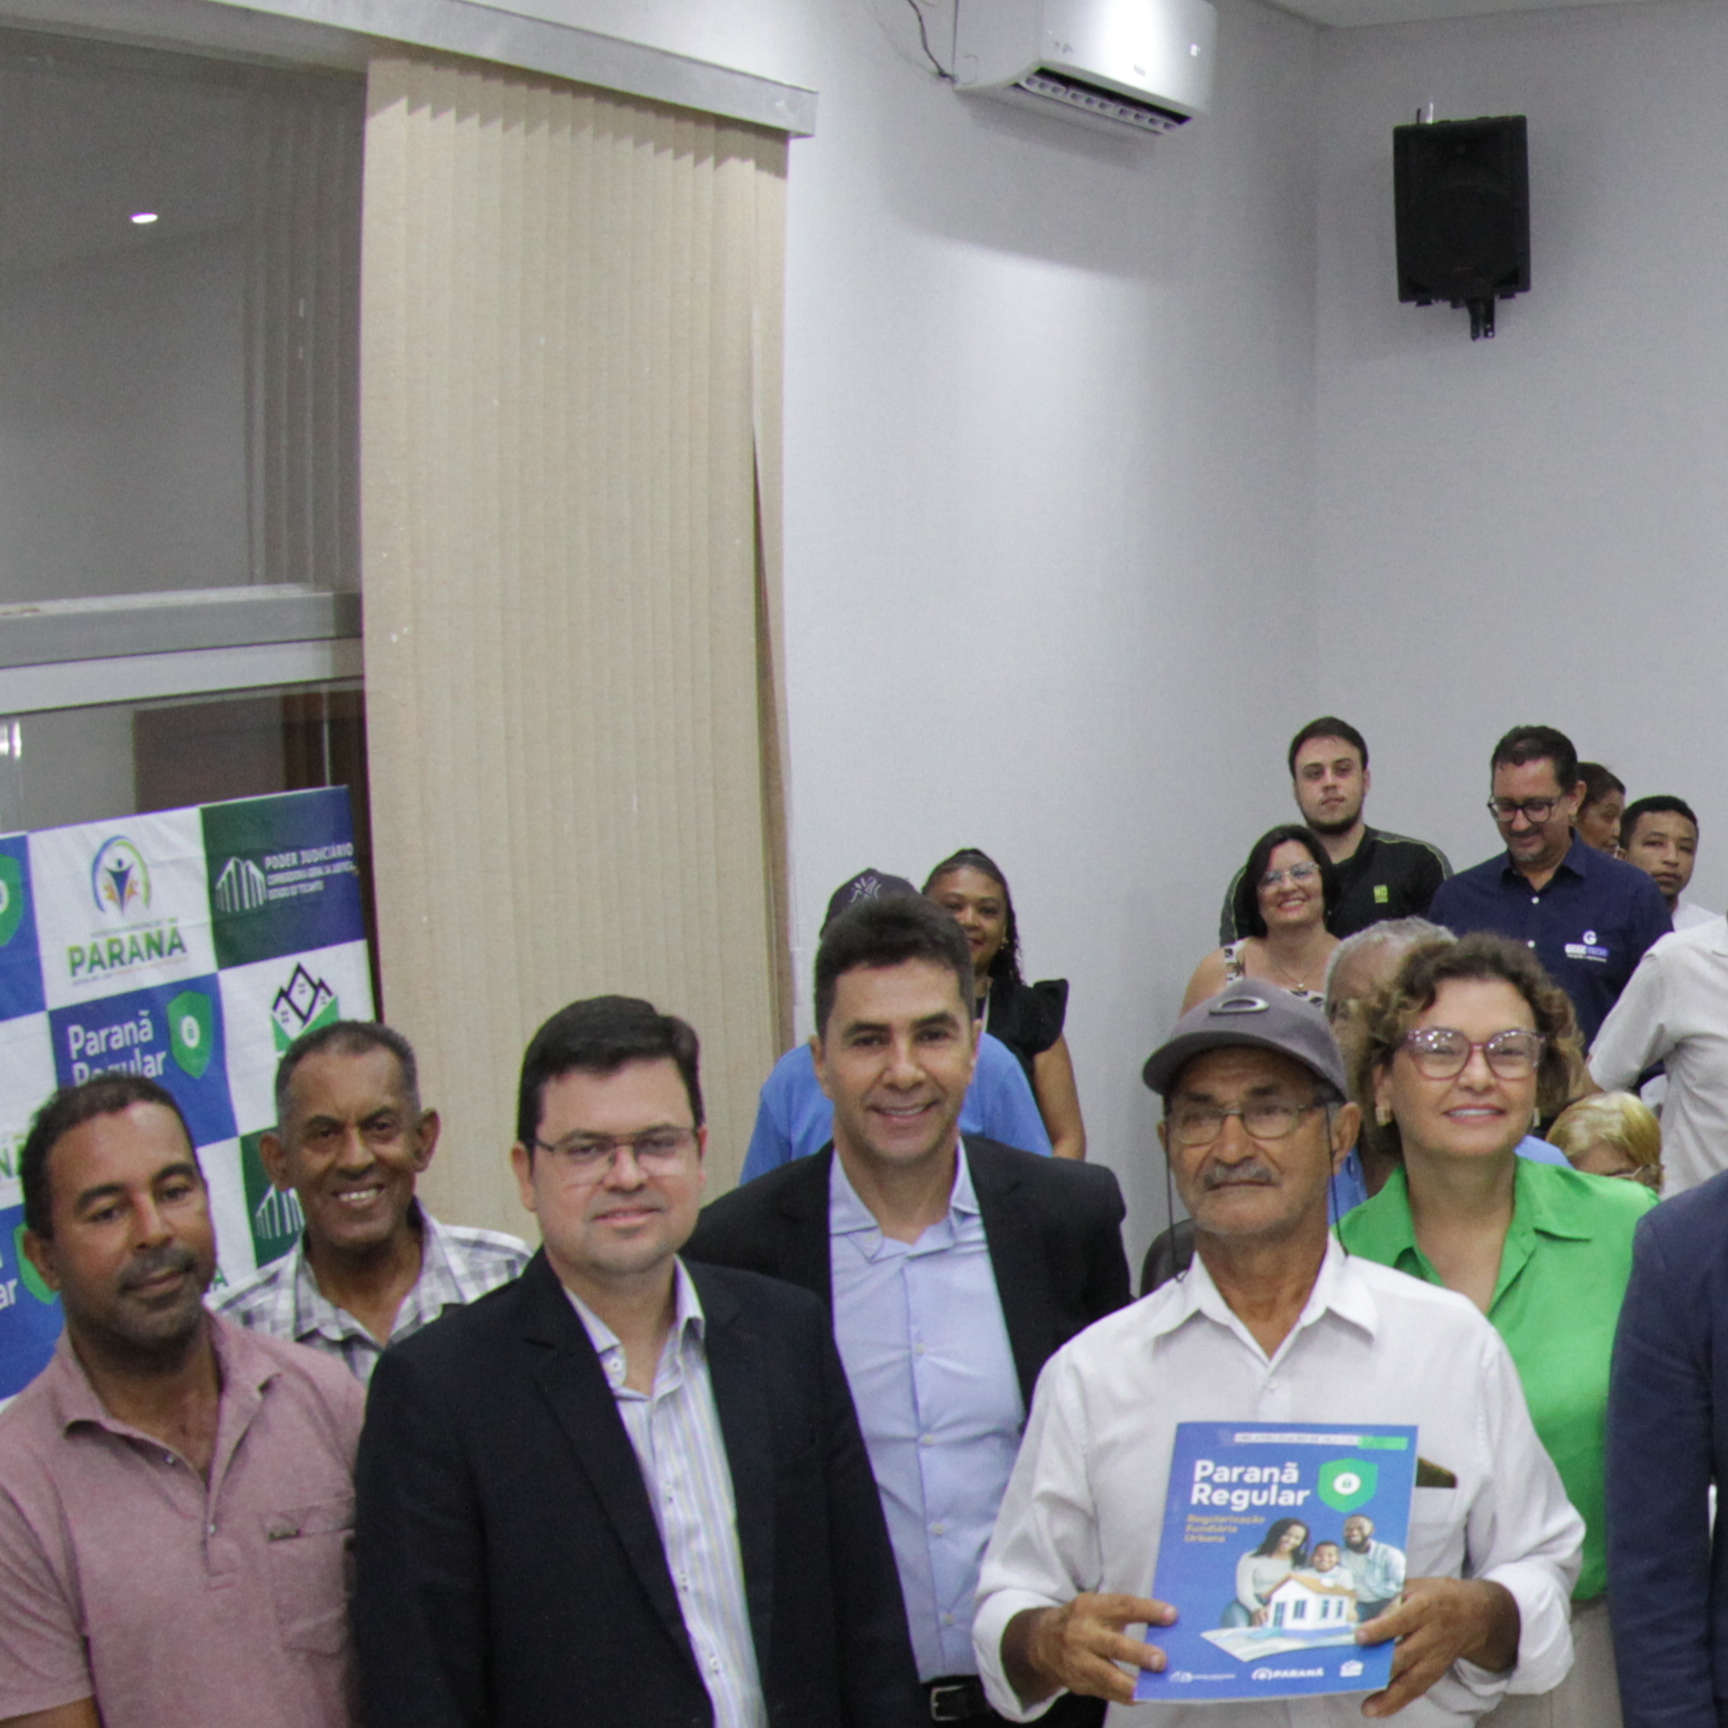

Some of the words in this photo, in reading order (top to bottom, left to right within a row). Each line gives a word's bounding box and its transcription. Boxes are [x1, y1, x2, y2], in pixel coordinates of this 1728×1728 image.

[1583, 930, 1597, 946] G
[67, 1009, 154, 1060] Paranã
[1193, 1459, 1300, 1485] Paranã
[1190, 1483, 1311, 1511] Regular
